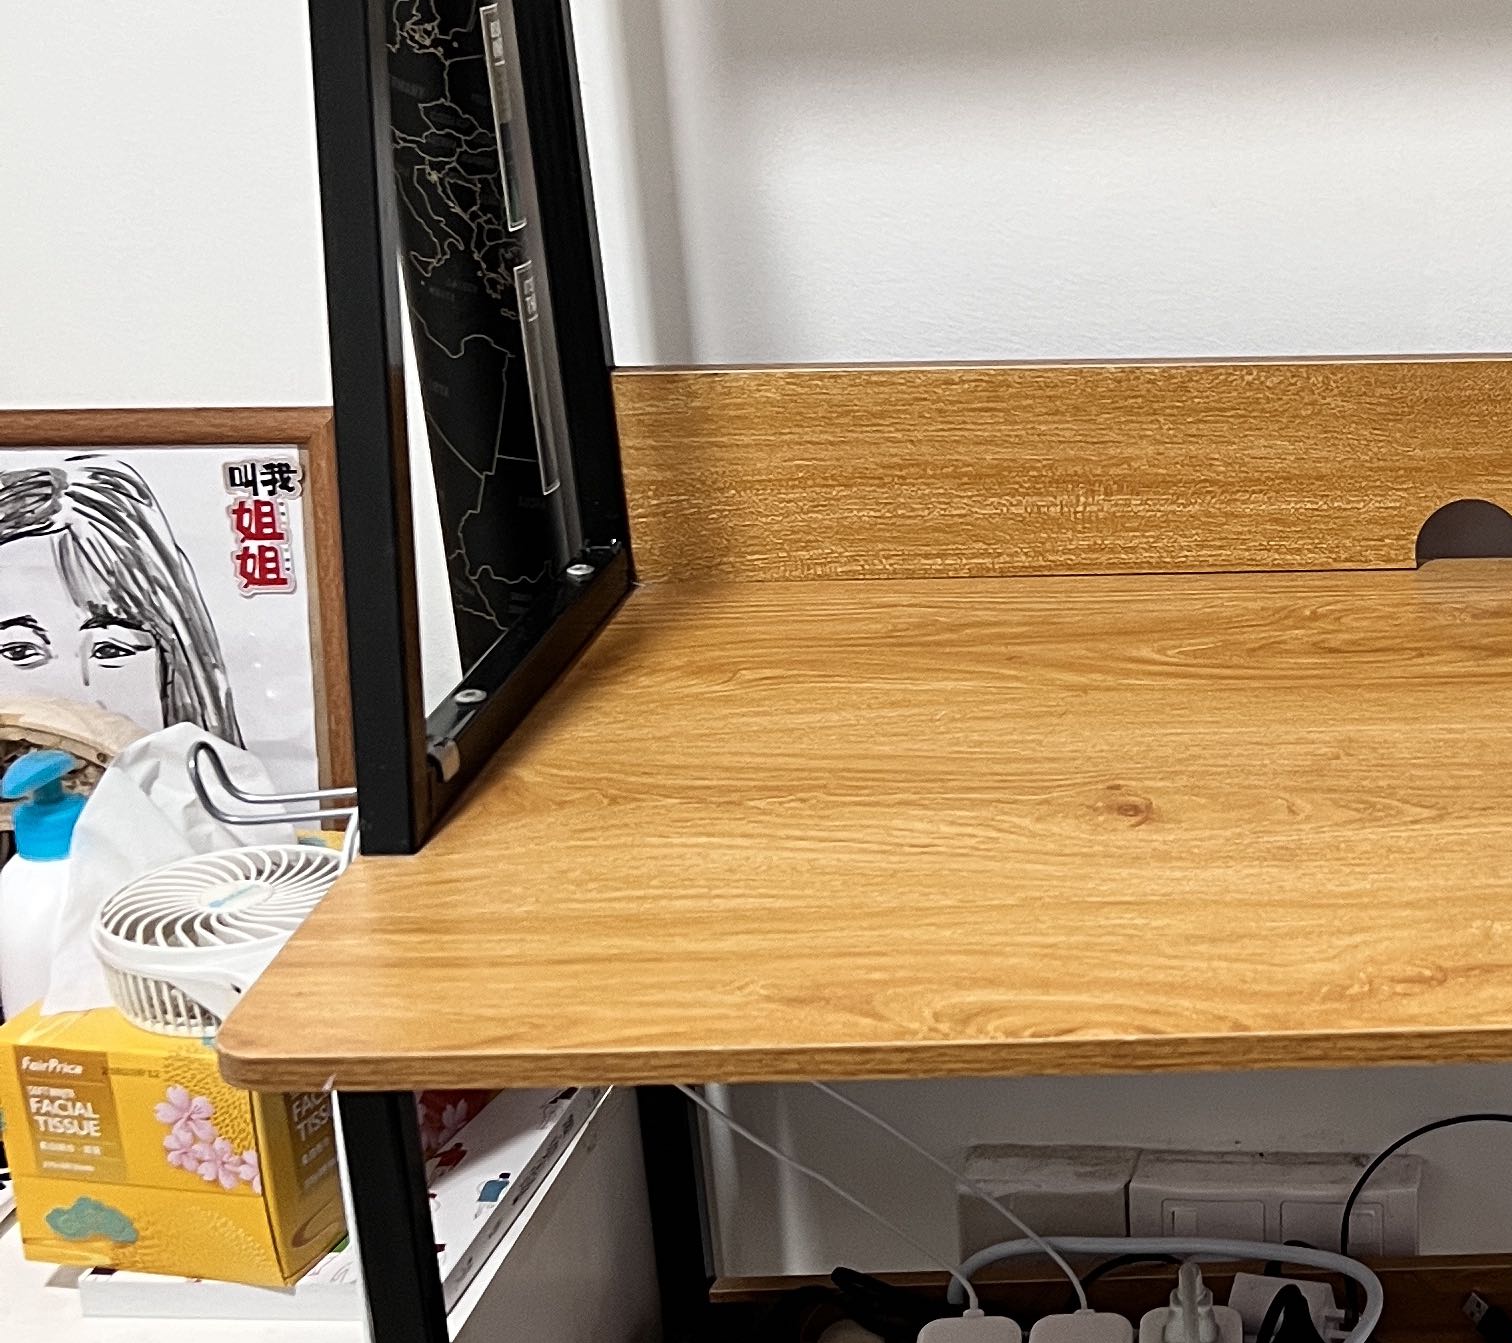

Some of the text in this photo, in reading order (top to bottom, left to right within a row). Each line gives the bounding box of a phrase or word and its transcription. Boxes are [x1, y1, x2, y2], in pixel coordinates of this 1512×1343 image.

[228, 462, 298, 497] 叫我
[21, 1055, 84, 1075] FairPrice
[29, 1097, 100, 1119] FACIAL
[33, 1115, 102, 1137] TISSUE
